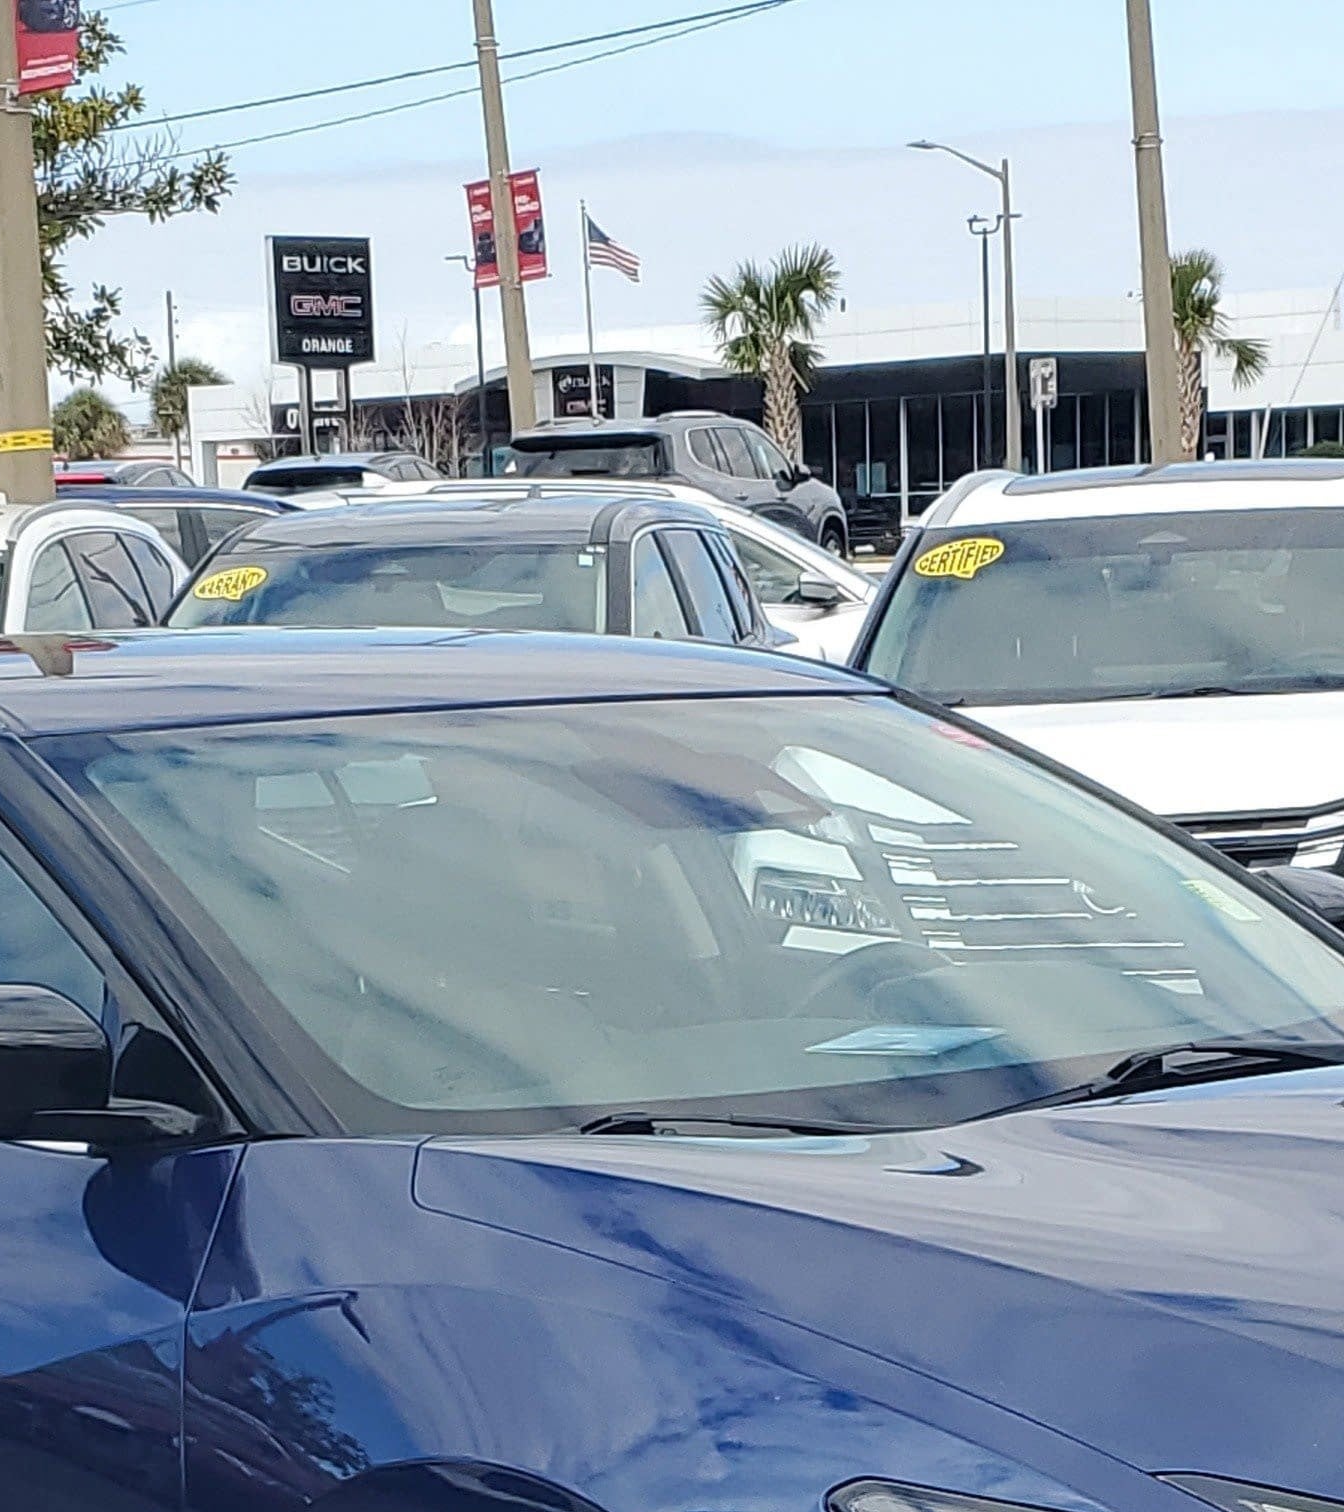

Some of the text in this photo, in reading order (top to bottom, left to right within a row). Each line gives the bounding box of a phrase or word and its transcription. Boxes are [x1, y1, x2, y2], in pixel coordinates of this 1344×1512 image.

[282, 254, 366, 273] BUICK
[290, 294, 362, 317] GMC
[301, 337, 354, 353] ORANGE
[919, 545, 1000, 573] CERTIFIED
